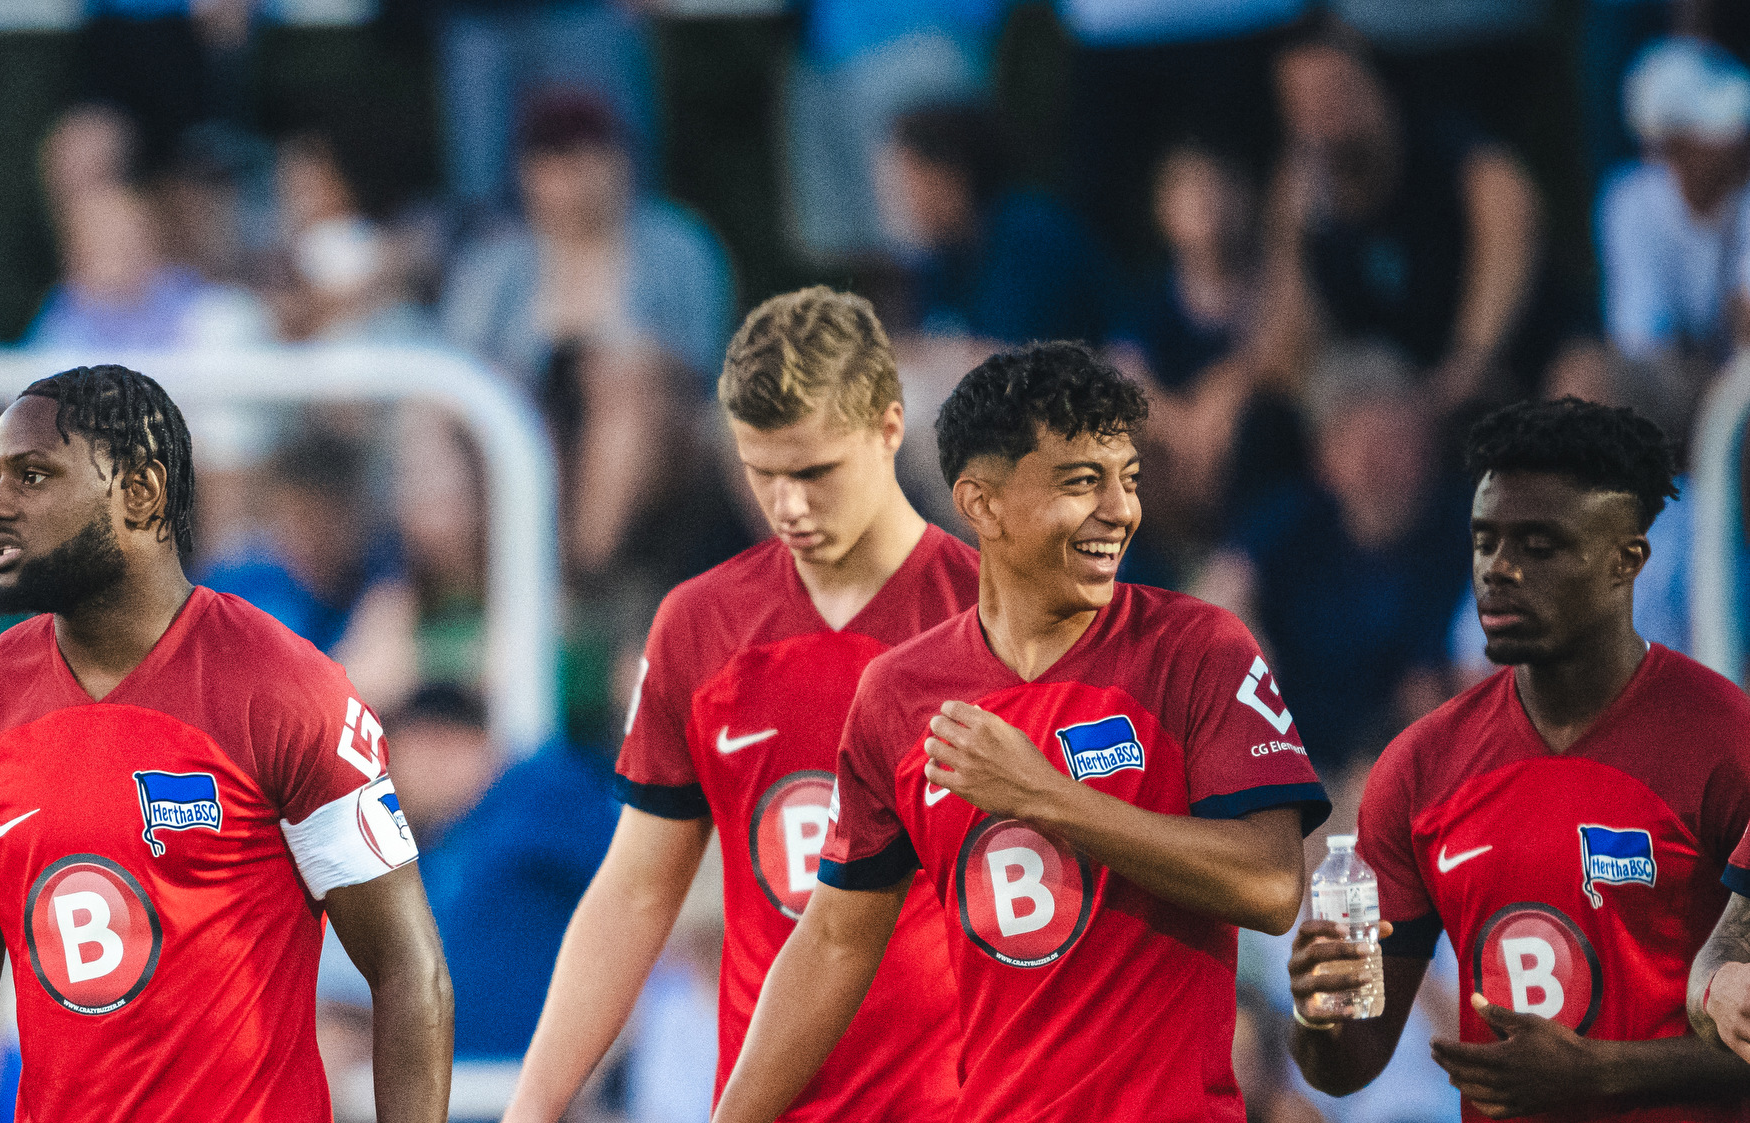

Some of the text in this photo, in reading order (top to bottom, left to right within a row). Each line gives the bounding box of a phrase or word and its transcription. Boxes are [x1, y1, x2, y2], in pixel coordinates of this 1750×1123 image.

[1251, 743, 1269, 757] CG
[986, 846, 1056, 938] B
[53, 890, 124, 984] B
[1501, 936, 1565, 1020] B
